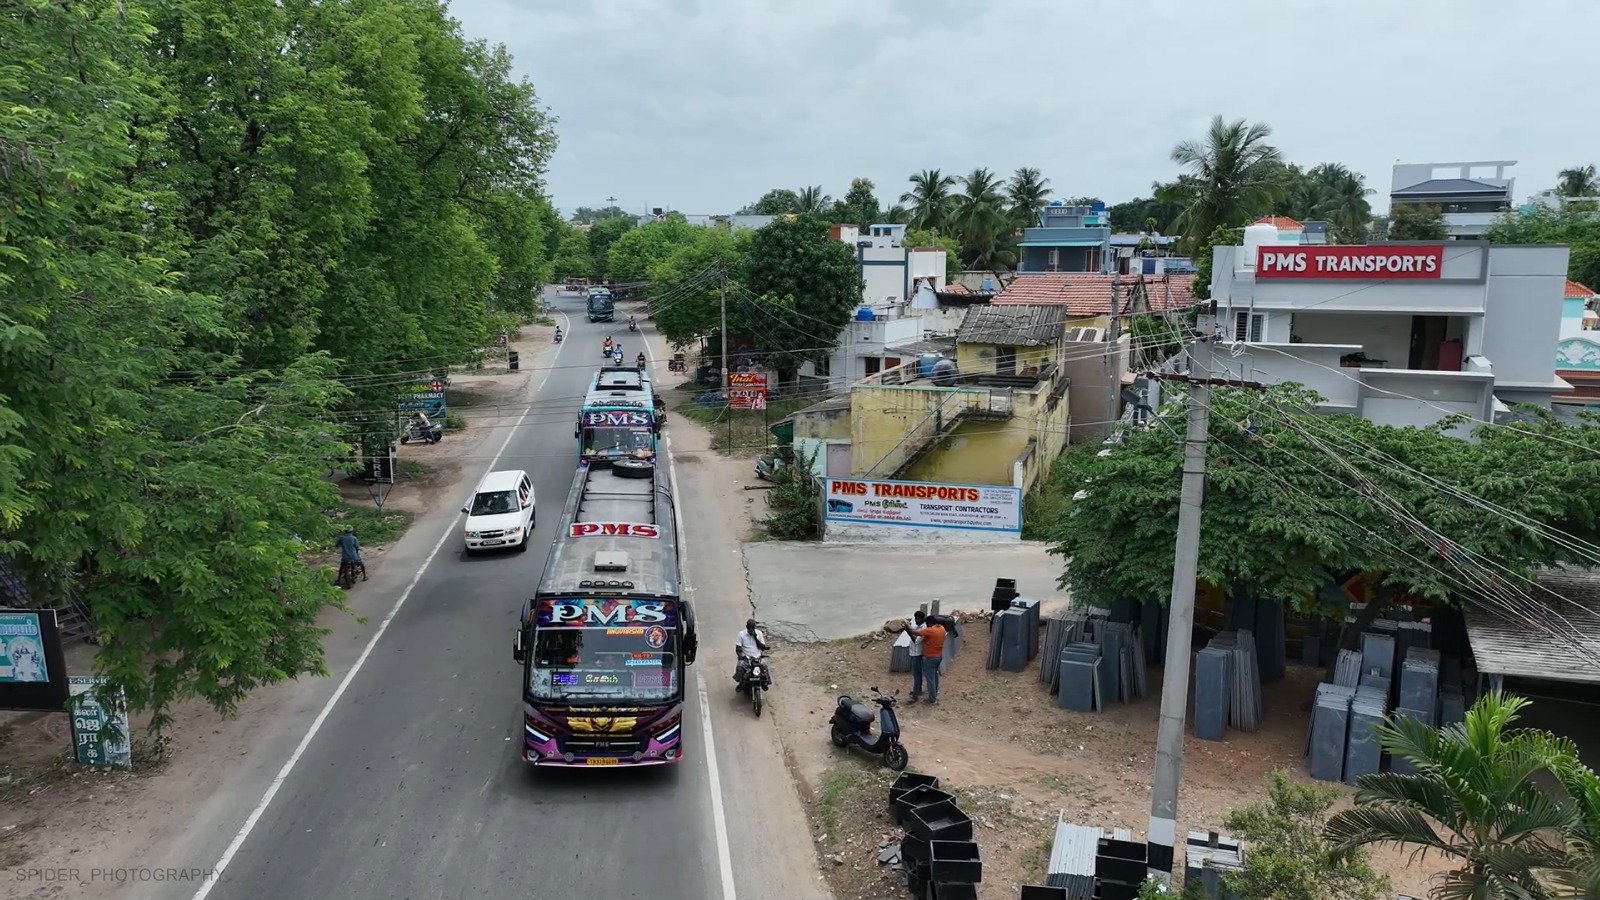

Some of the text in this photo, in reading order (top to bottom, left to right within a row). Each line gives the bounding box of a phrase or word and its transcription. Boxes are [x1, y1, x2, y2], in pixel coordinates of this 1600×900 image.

[1262, 252, 1437, 273] PMS TRANSPORTS
[589, 413, 649, 426] PMS
[831, 480, 980, 502] PMS TRANSPORTS
[864, 500, 881, 508] PMS
[920, 503, 999, 514] TRANSPORT CONTRACTORS
[571, 523, 658, 537] PMS
[550, 604, 667, 625] PMS
[68, 676, 112, 686] E-SERVIC
